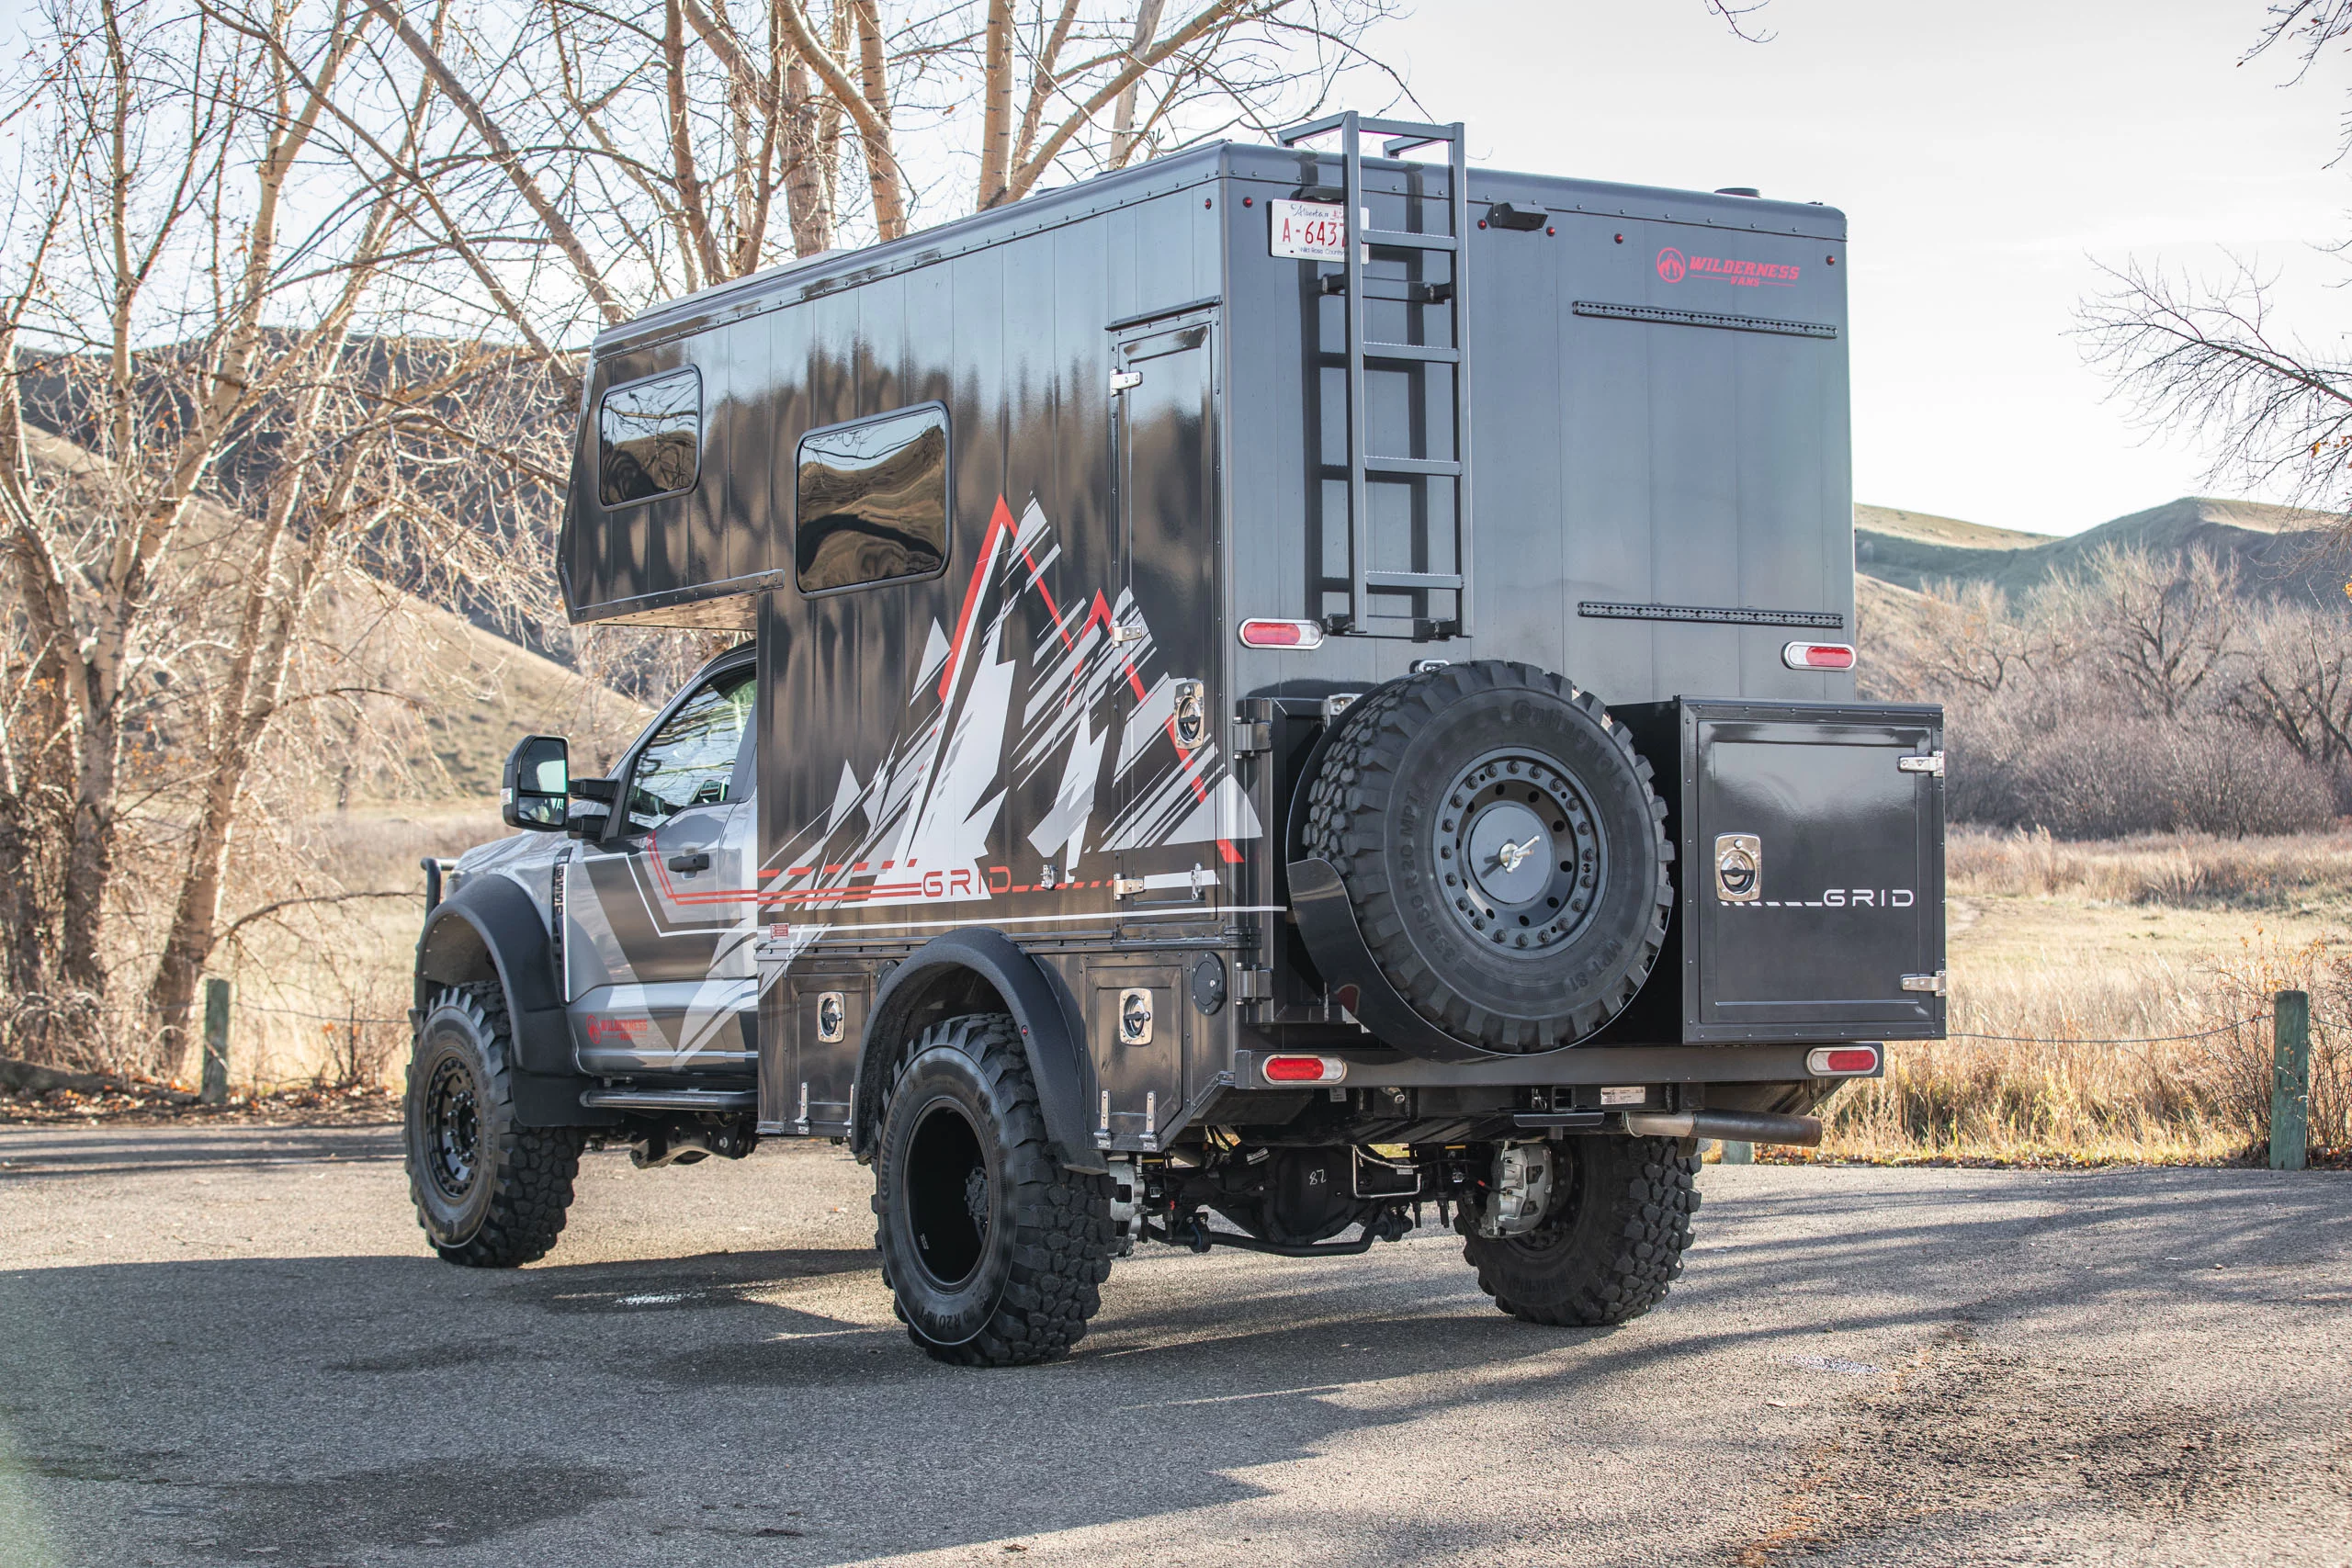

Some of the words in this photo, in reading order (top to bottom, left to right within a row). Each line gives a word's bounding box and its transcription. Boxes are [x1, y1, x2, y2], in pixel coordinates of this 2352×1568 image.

[1291, 204, 1323, 217] Alberta
[1690, 256, 1801, 280] WILDERNESS
[1730, 276, 1759, 288] VANS
[923, 866, 1011, 897] GRID
[1824, 889, 1914, 908] GRID
